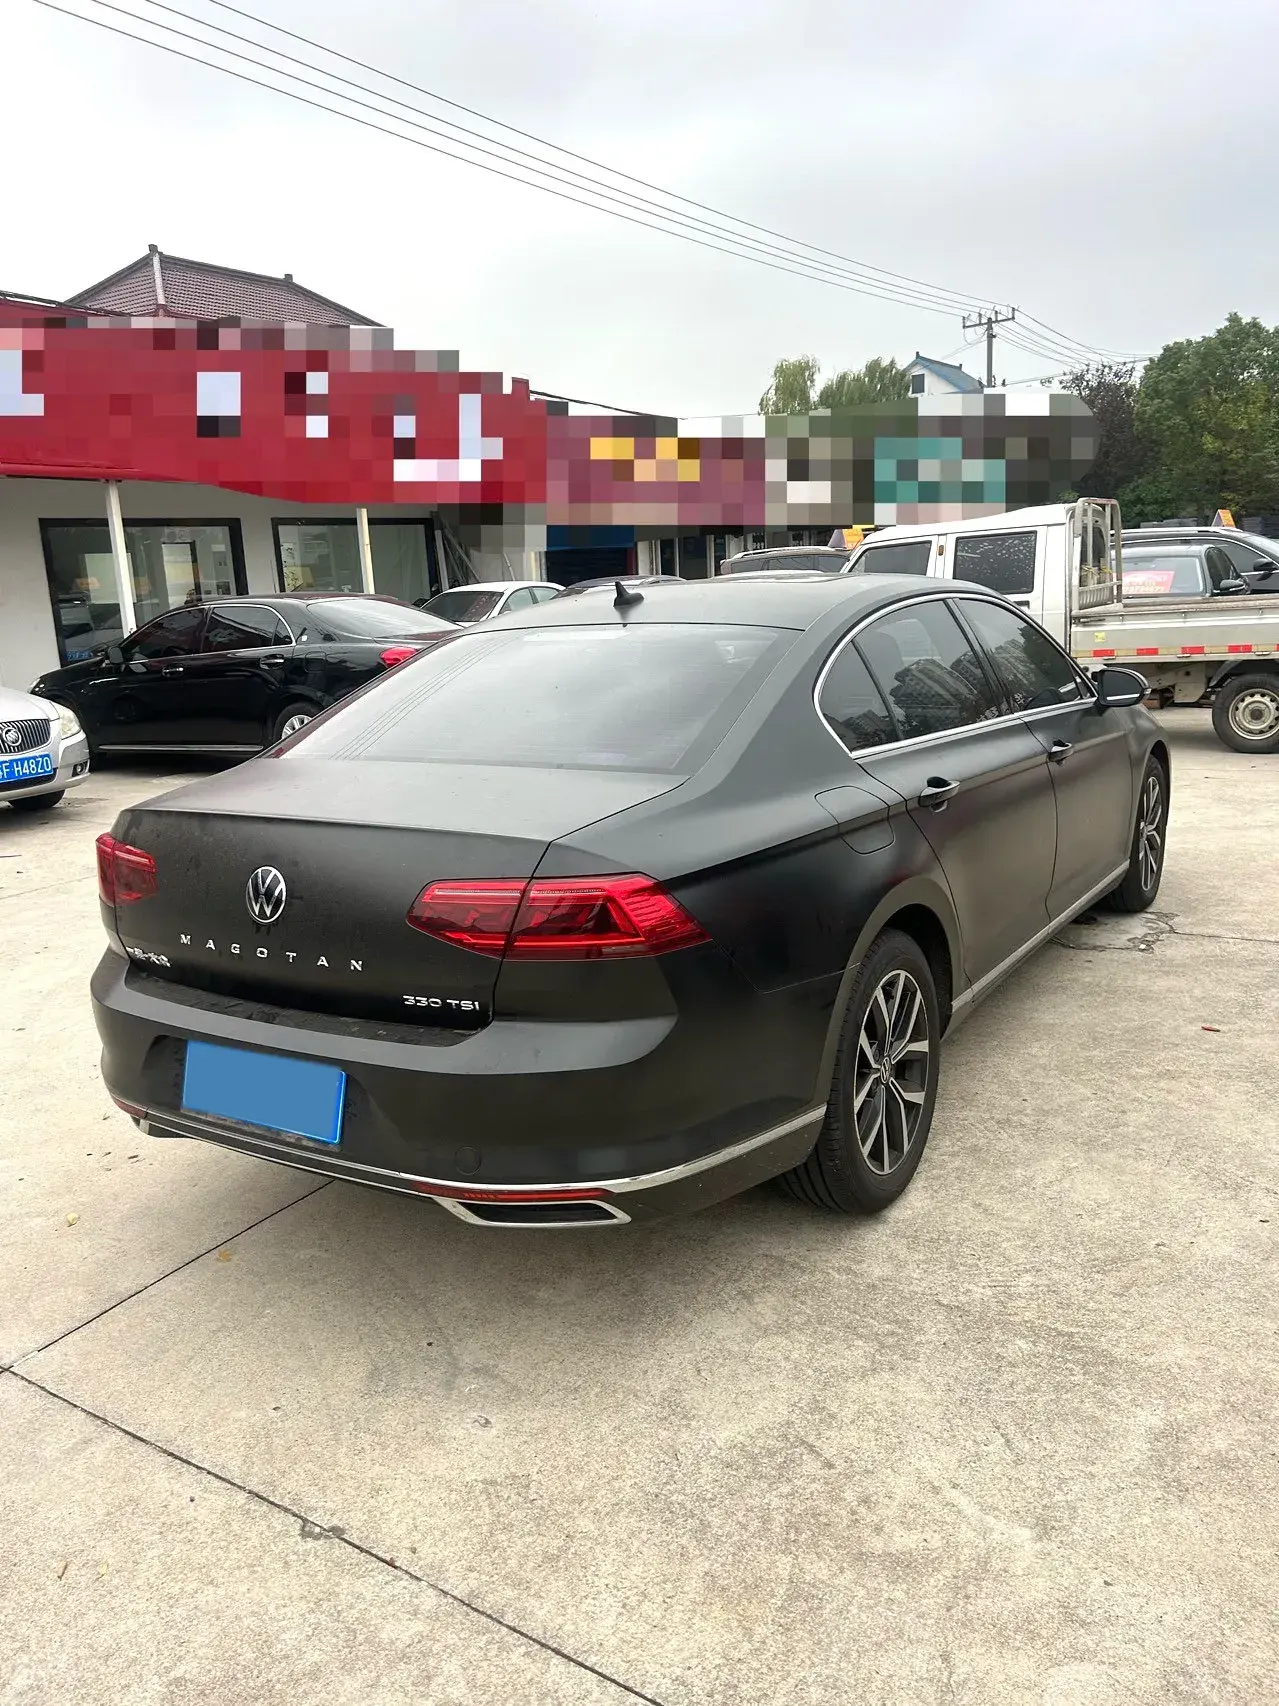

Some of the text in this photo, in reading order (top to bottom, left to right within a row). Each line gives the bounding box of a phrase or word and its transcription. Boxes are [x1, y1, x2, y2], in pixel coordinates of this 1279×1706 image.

[180, 934, 363, 971] MAGOTAN
[402, 995, 480, 1011] 330 TSI
